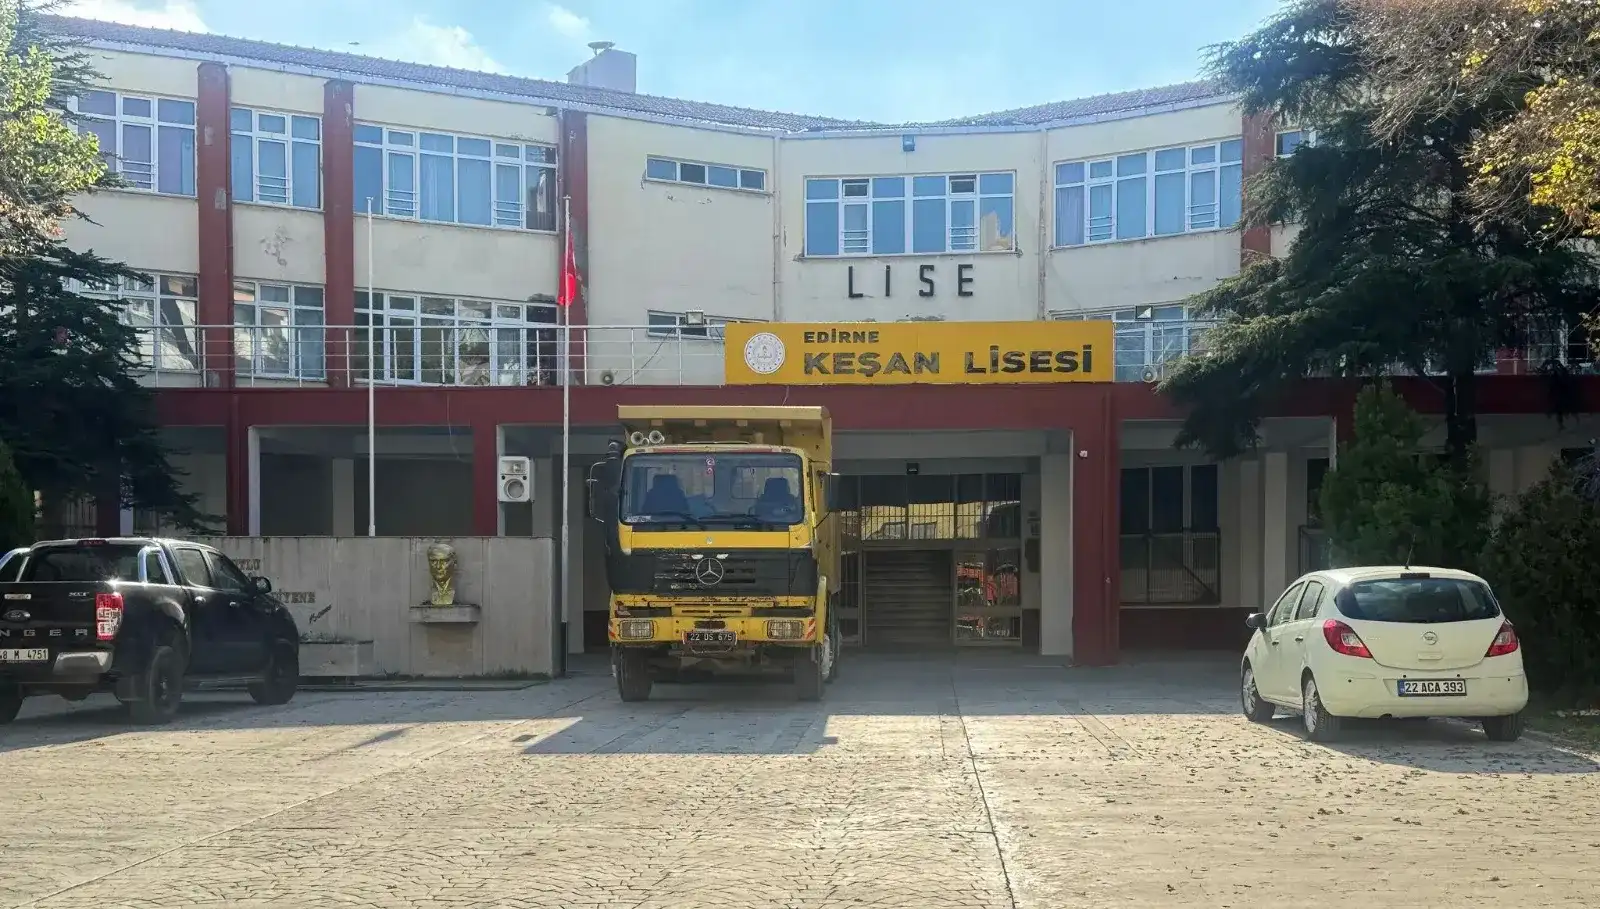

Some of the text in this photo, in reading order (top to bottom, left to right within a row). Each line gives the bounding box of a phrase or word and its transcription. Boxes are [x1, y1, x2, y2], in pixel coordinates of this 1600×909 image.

[847, 263, 974, 299] LİSE
[803, 327, 880, 344] EDİRNE
[803, 351, 940, 378] KEŞAN
[964, 344, 1093, 375] LİSESİ
[690, 633, 700, 641] 22
[718, 633, 732, 641] 675
[14, 649, 20, 660] M
[27, 649, 48, 660] 4751
[1405, 682, 1418, 693] 22
[1421, 682, 1441, 693] ACA
[1443, 681, 1464, 692] 393
